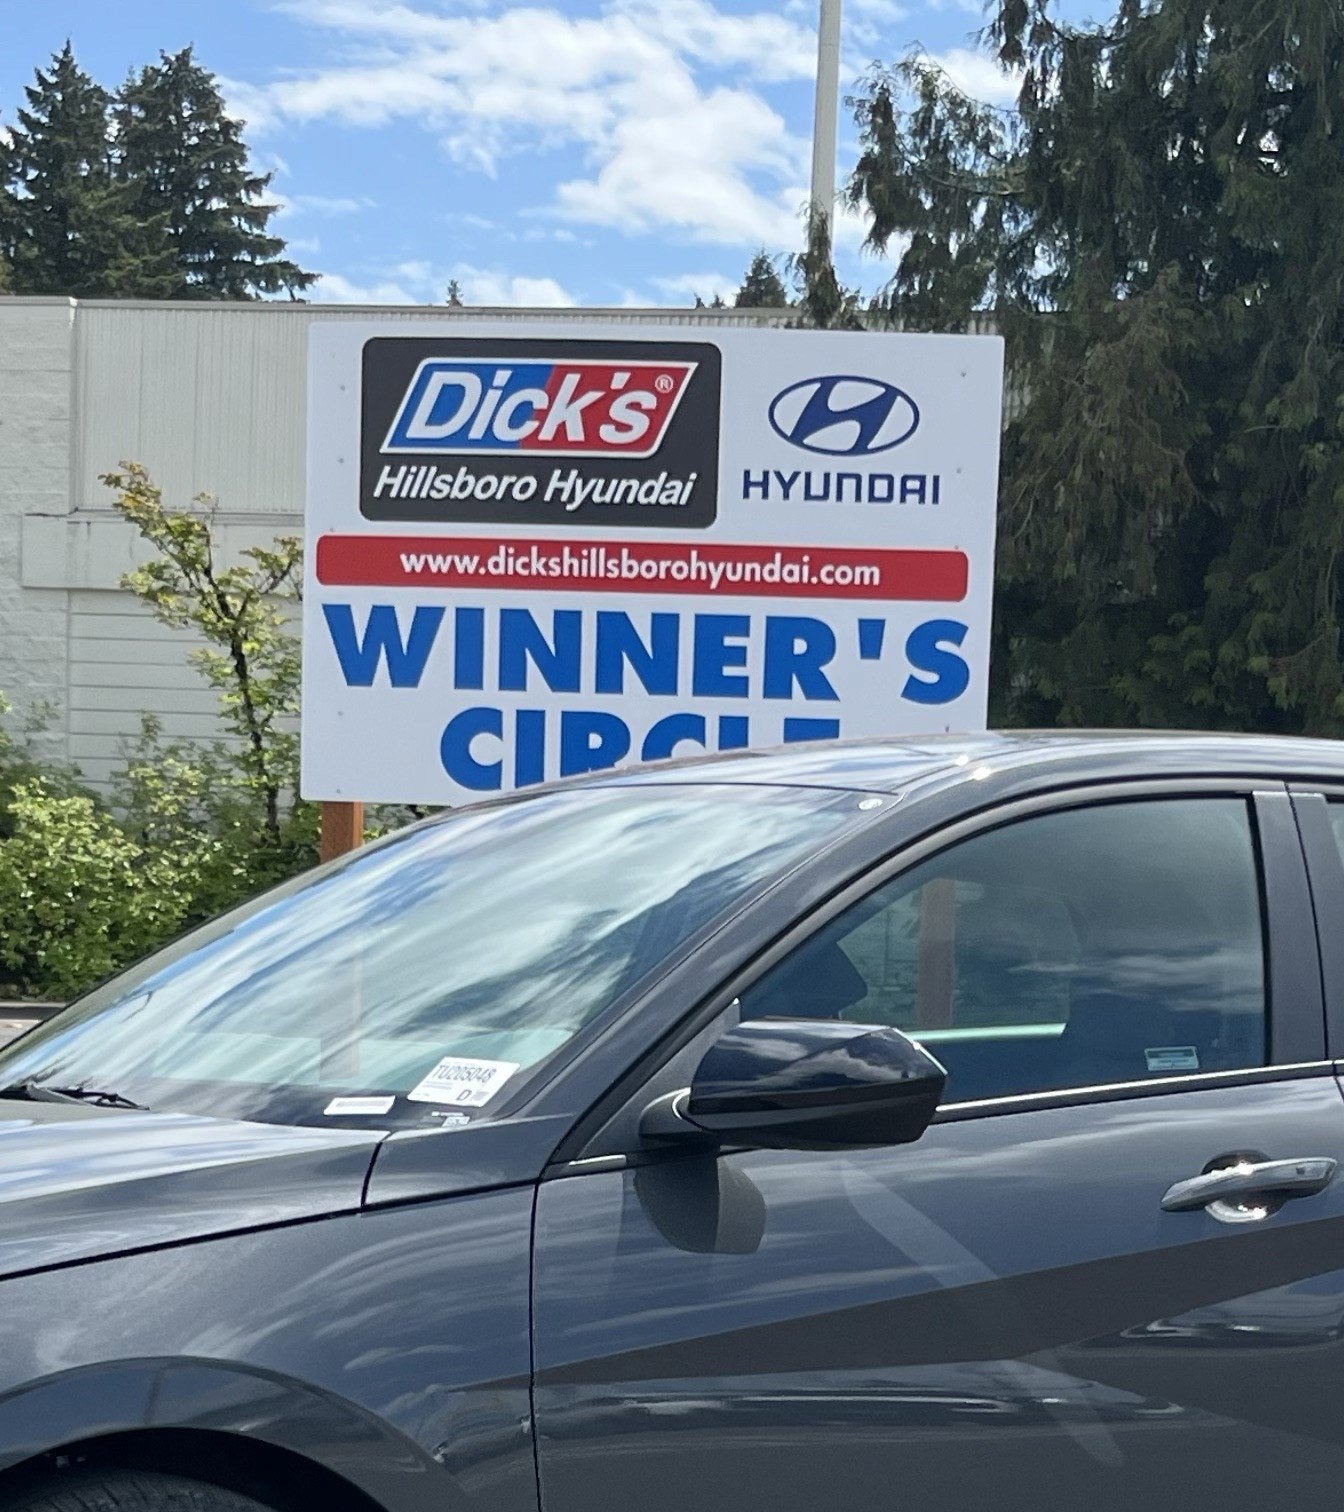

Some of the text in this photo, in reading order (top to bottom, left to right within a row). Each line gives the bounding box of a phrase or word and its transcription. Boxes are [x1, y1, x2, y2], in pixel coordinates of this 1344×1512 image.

[372, 464, 698, 510] Hillsboro Hyundai
[742, 469, 940, 505] HYUNDAI
[400, 546, 881, 589] www.dickshillsborohyundai.com
[322, 603, 970, 705] WINNER'S
[440, 706, 840, 791] CIRC
